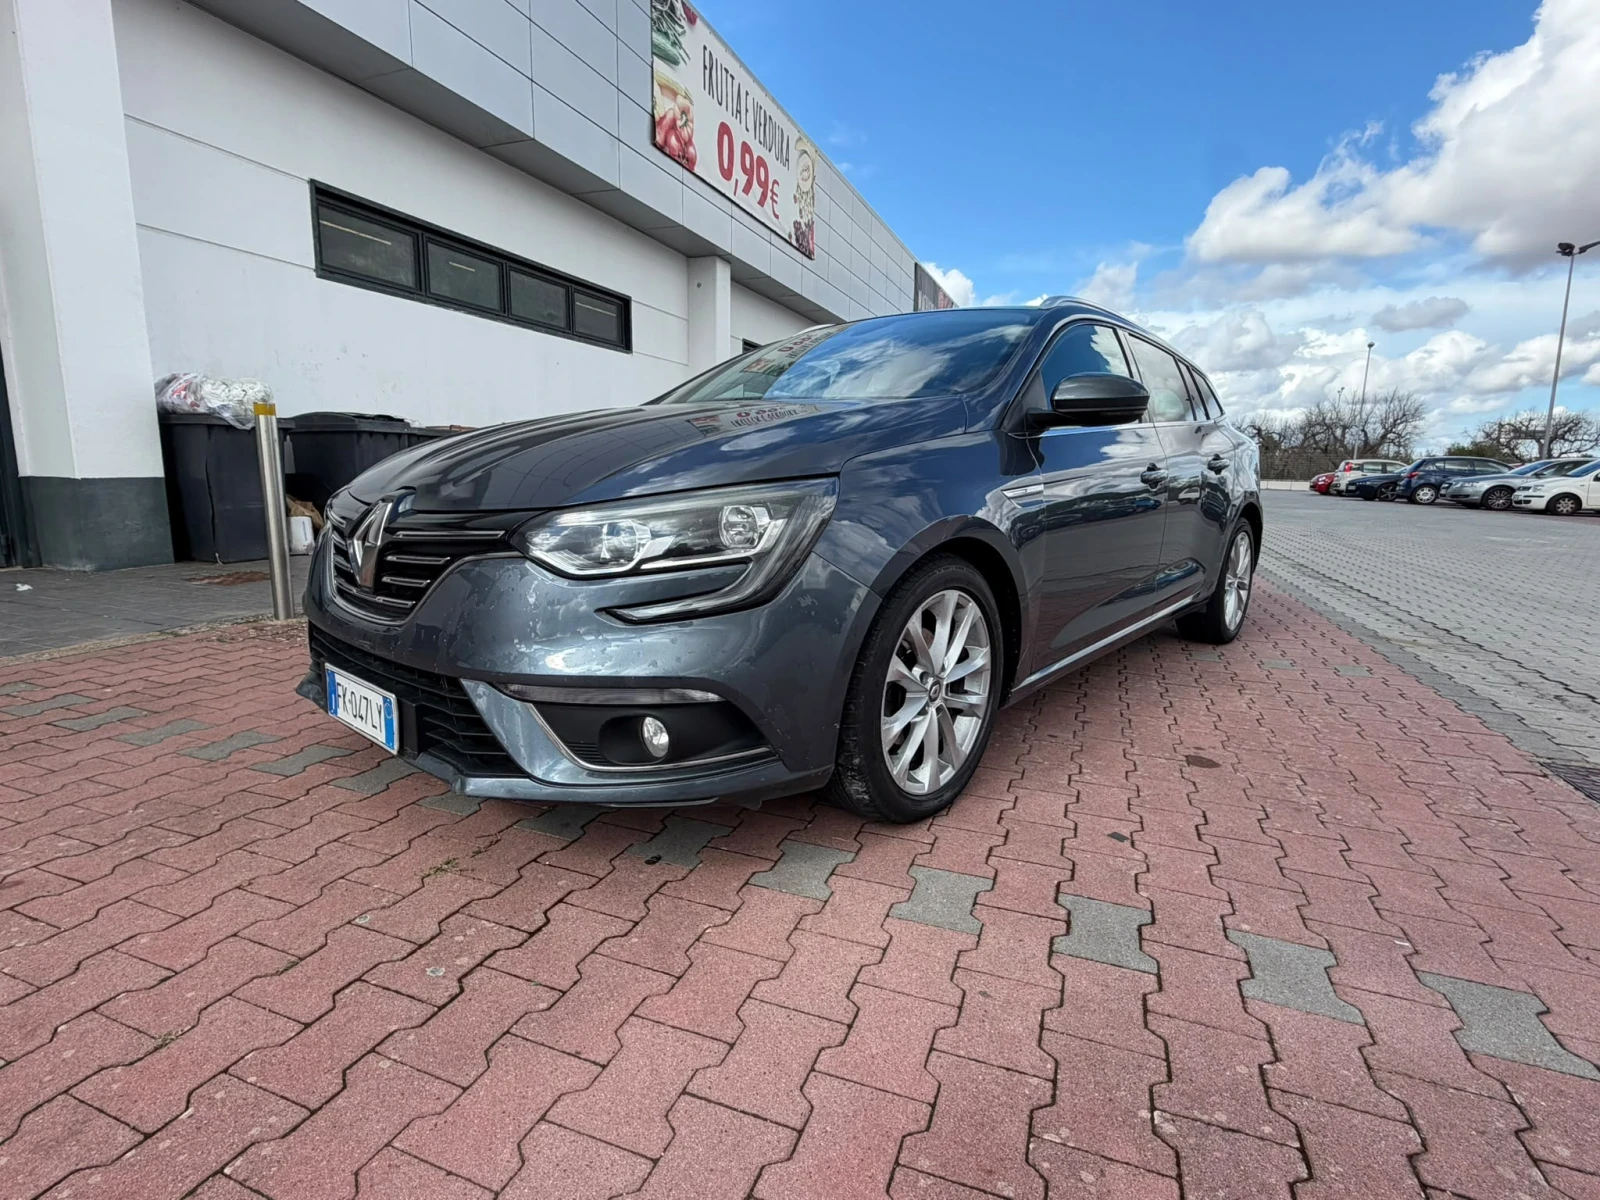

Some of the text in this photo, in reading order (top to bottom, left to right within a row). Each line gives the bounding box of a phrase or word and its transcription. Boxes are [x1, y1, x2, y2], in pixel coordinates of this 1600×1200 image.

[702, 44, 790, 171] FRUTTA E VERDURA
